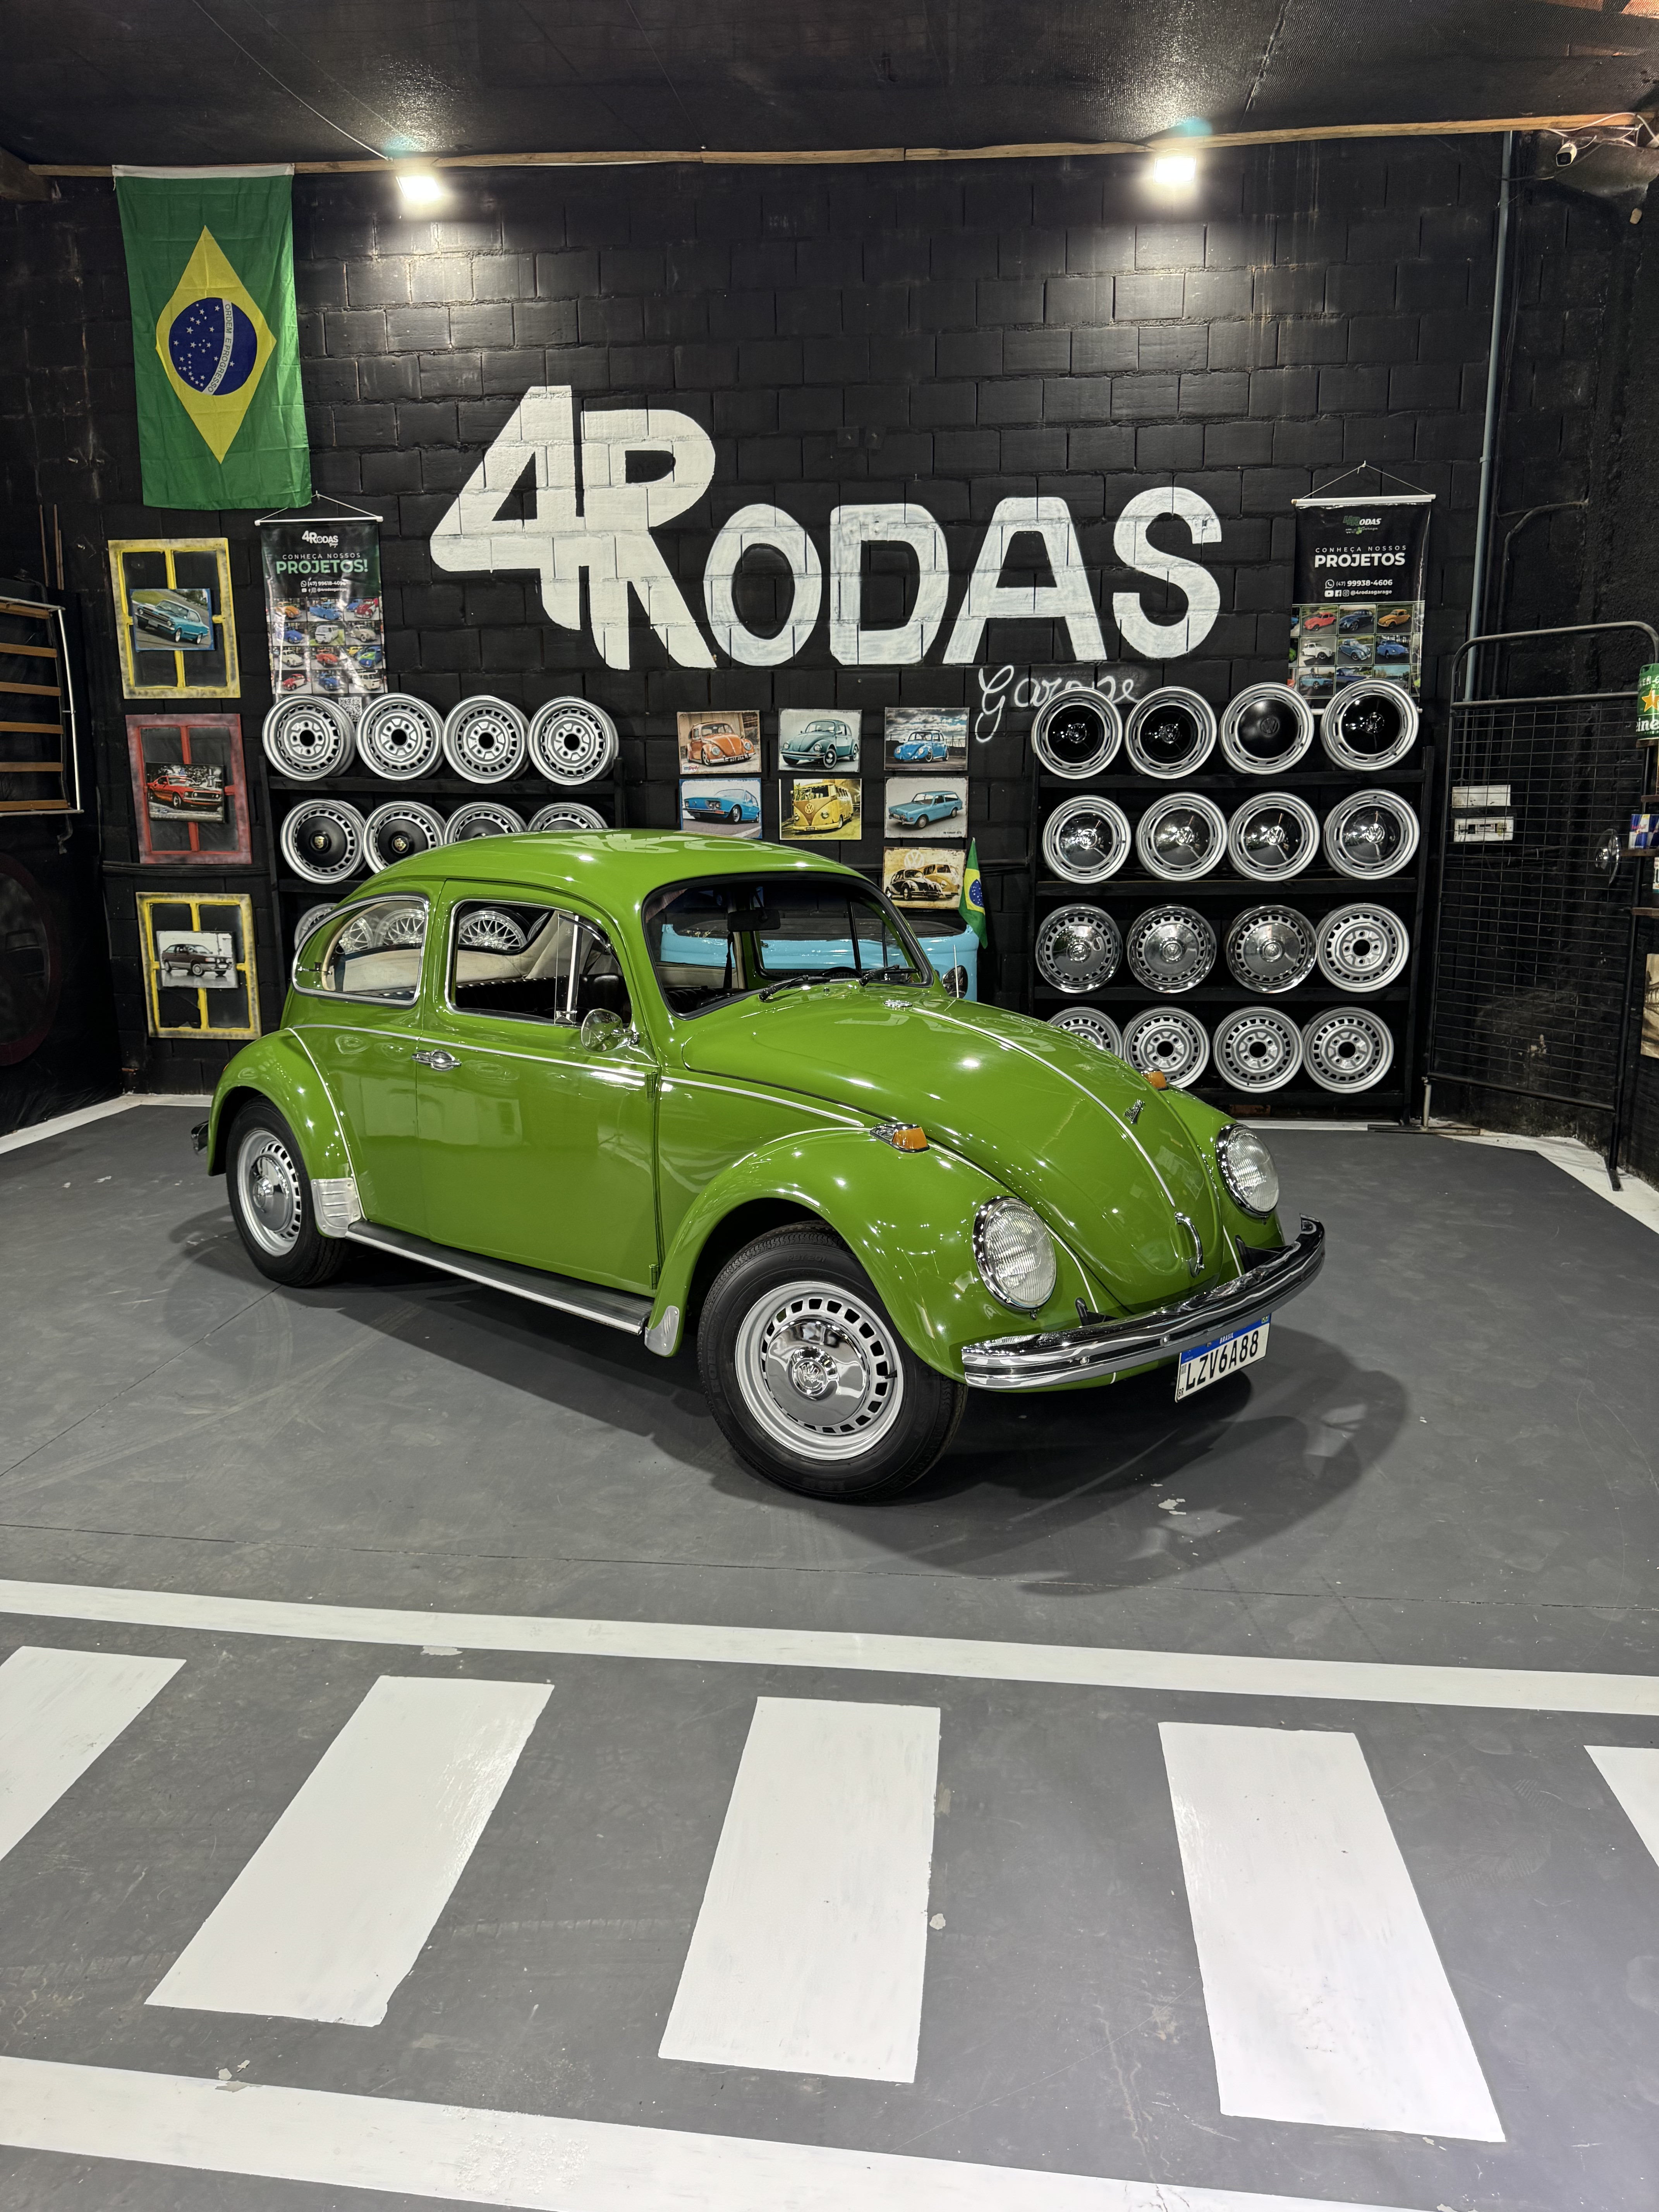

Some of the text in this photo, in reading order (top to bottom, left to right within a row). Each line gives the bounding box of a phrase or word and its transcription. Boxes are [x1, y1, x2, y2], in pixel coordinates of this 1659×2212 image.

[224, 304, 233, 334] ORDEM
[208, 345, 232, 393] PROGRESSO
[276, 559, 368, 574] PROJETOS!
[1314, 552, 1405, 568] PROJETOS
[1219, 1332, 1234, 1344] BRASIL
[1185, 1330, 1259, 1391] LZV6A88
[1178, 1388, 1184, 1398] BR
